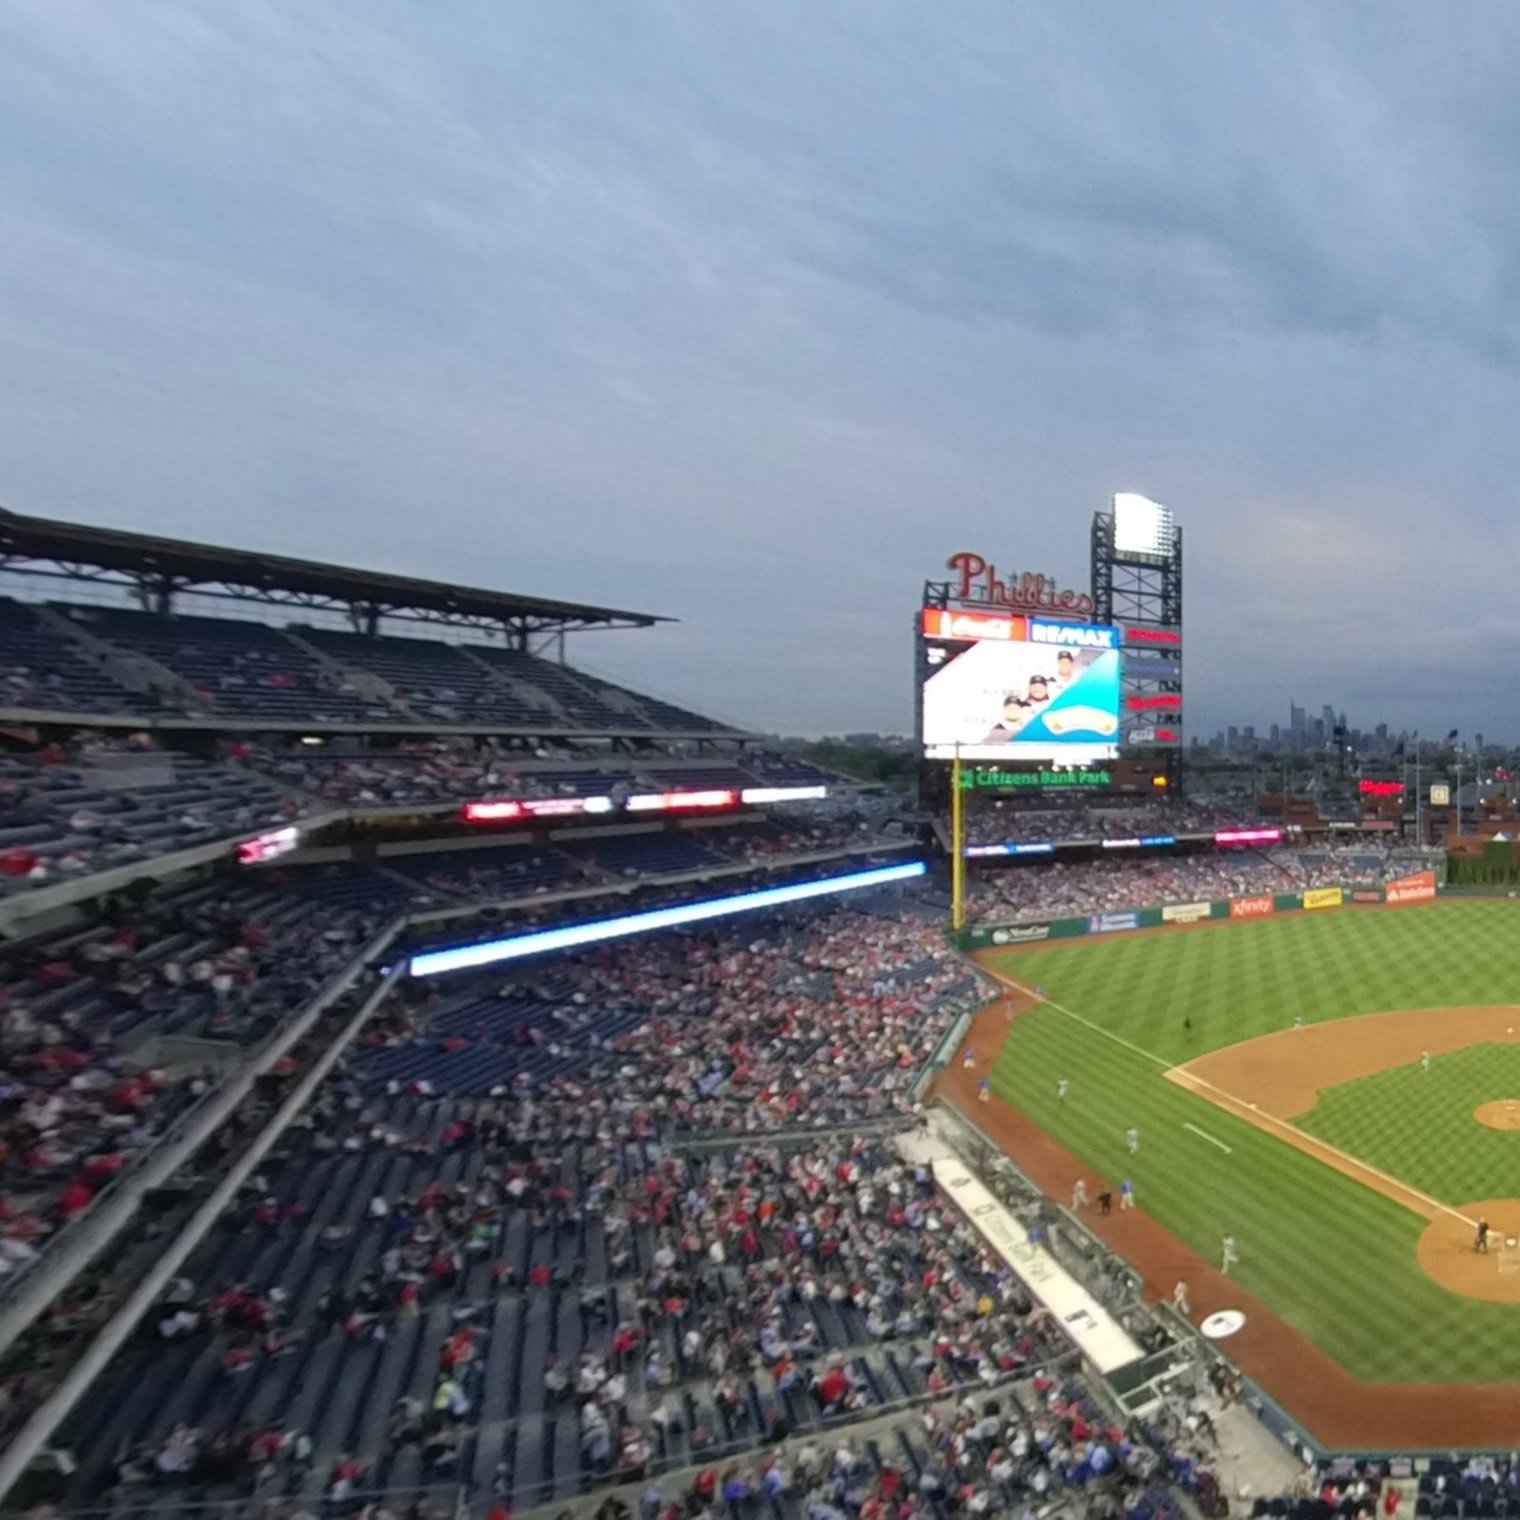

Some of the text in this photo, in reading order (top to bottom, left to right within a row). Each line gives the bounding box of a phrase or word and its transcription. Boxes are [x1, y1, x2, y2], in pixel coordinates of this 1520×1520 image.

[947, 552, 1096, 614] Phillies
[1032, 624, 1113, 648] RE/MAX
[976, 770, 1109, 785] Citizens Bank Park
[1233, 898, 1271, 916] xfinity
